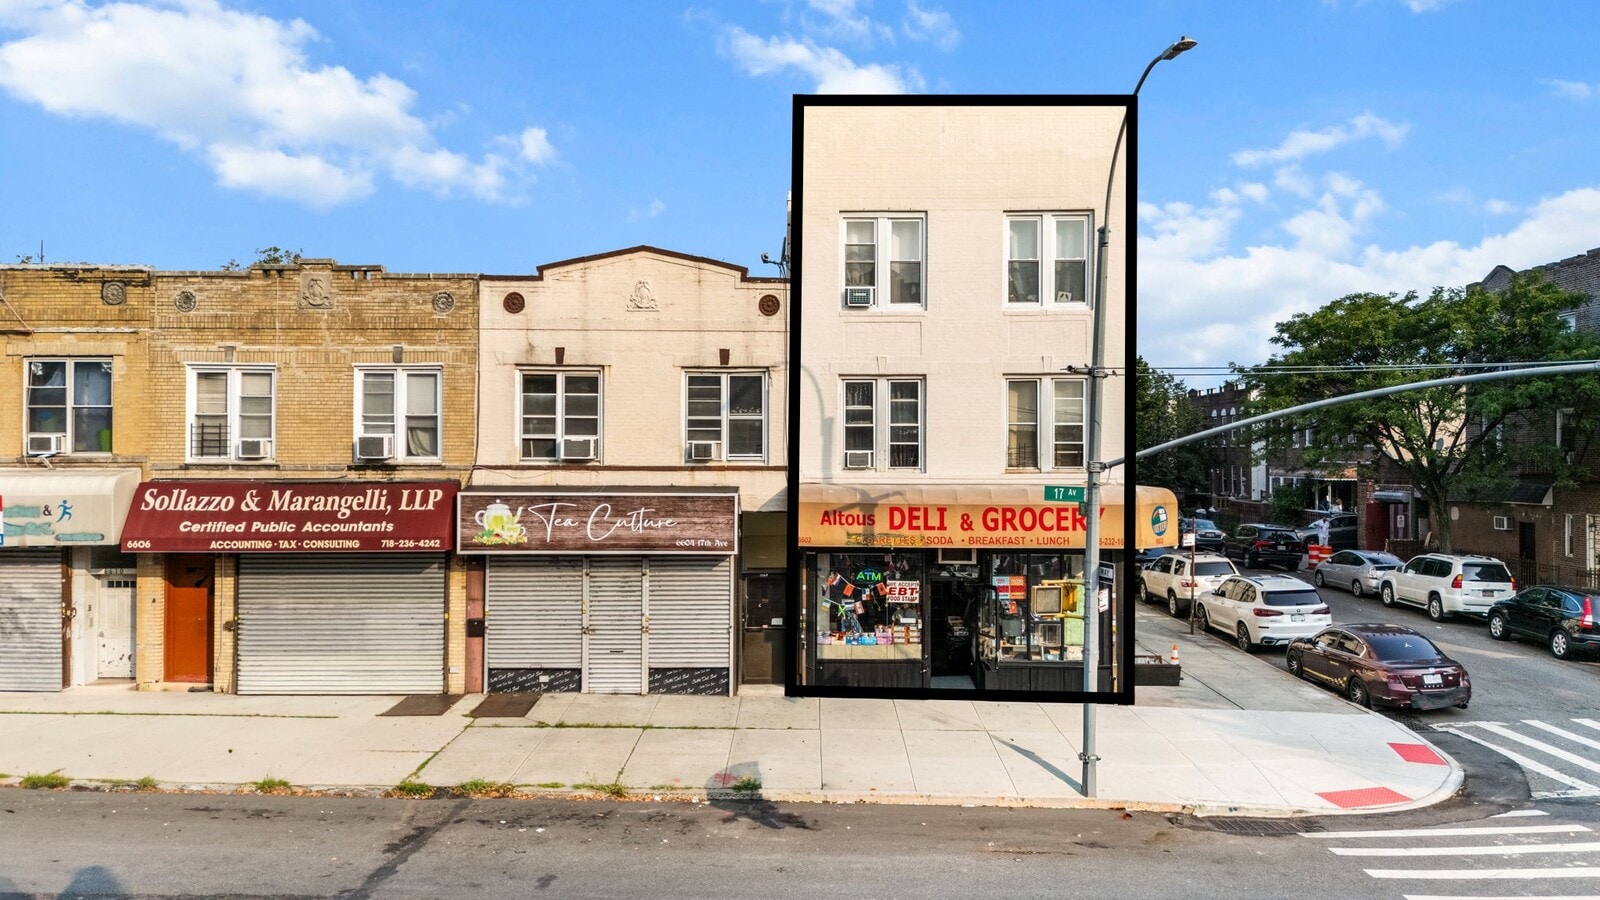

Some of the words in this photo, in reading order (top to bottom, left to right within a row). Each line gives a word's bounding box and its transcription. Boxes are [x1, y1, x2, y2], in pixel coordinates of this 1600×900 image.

[1054, 488, 1064, 499] 17
[1068, 489, 1077, 497] Av
[141, 488, 235, 511] Sollazzo
[240, 489, 261, 511] &
[266, 488, 392, 519] Marangelli,
[399, 488, 443, 511] LLP
[42, 504, 52, 516] &
[528, 503, 578, 542] Tea
[587, 503, 677, 540] Culture
[820, 509, 876, 526] Altous
[889, 506, 947, 531] DELI
[960, 513, 974, 531] &
[179, 521, 247, 532] Certified
[251, 521, 296, 532] Public
[302, 521, 394, 532] Accountants
[126, 540, 151, 548] 6606
[210, 540, 273, 549] ACCOUNTING
[279, 540, 297, 549] TAX
[303, 540, 360, 549] CONSULTING
[381, 539, 441, 548] 718-236-4242
[697, 539, 711, 547] 17th
[714, 539, 728, 547] Ave
[926, 536, 953, 545] SODA
[968, 536, 1026, 545] BREAKFAST
[1037, 537, 1070, 546] LUNCH
[856, 571, 882, 581] ATM
[888, 587, 918, 596] EBT
